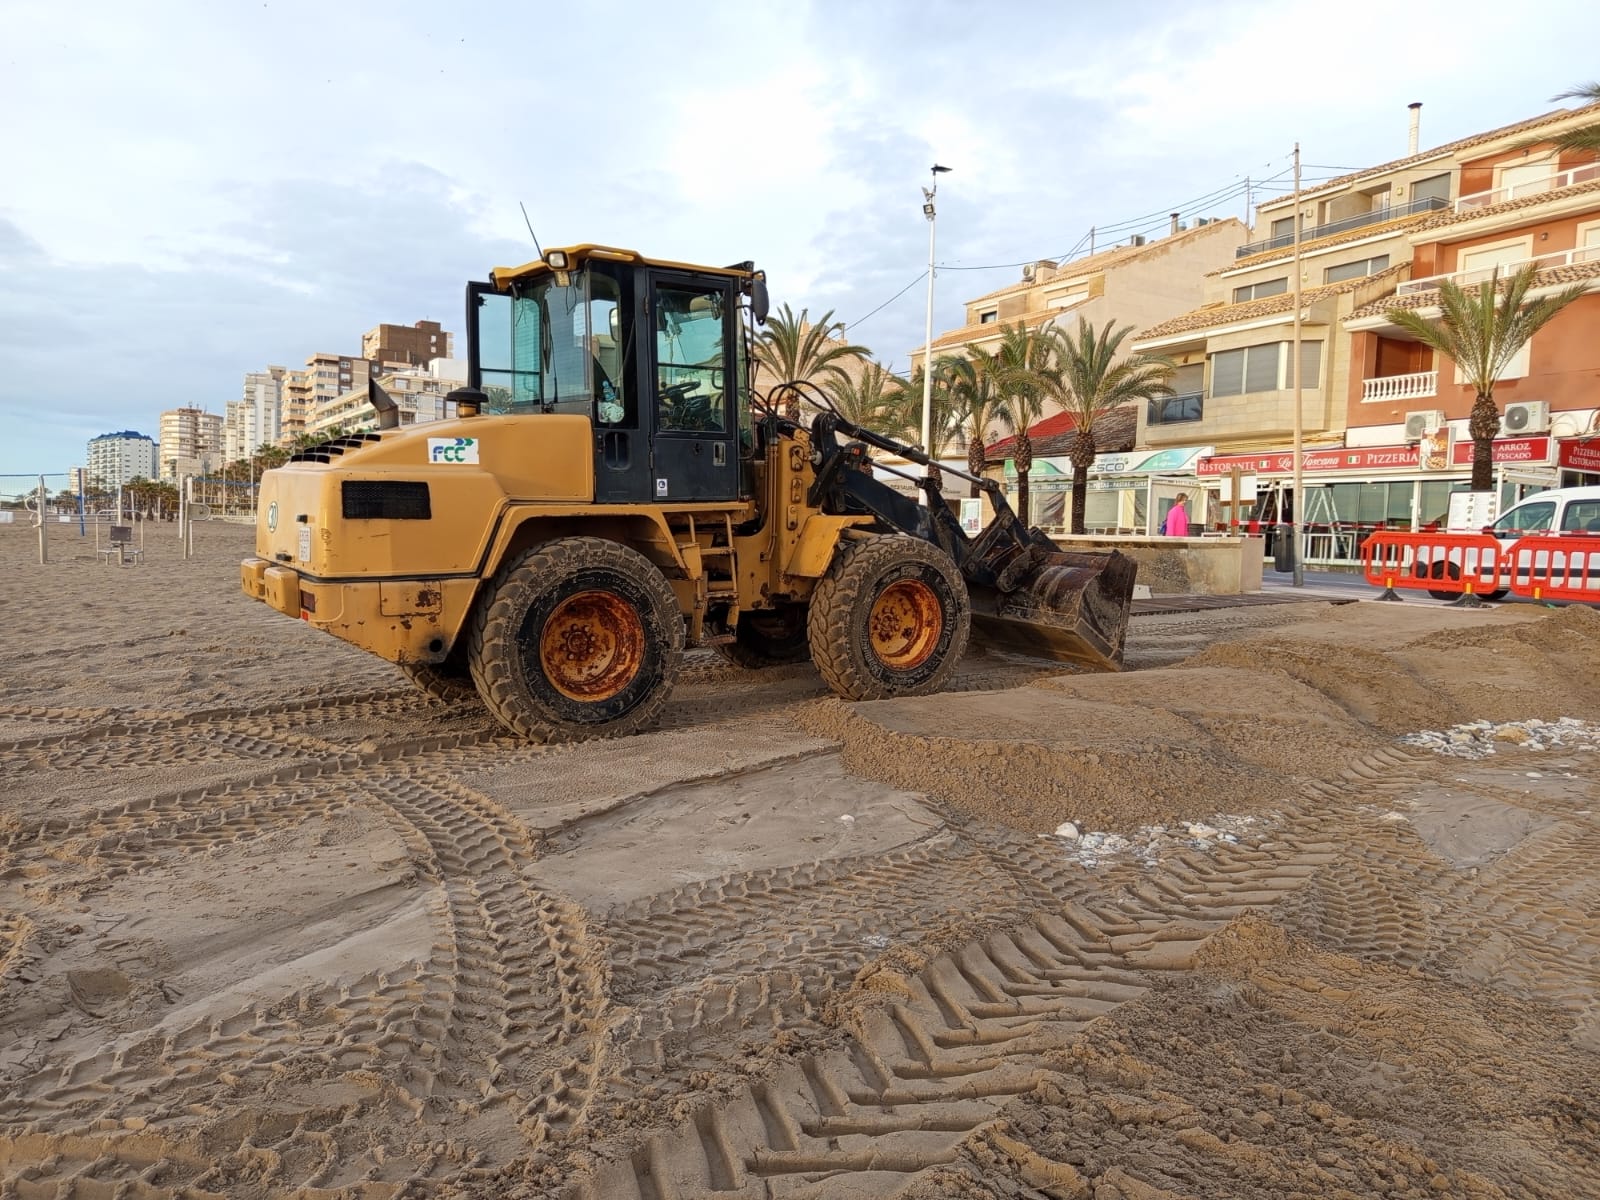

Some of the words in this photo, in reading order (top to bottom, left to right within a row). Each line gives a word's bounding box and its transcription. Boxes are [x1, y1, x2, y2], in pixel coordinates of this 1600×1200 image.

[433, 446, 466, 462] FCC
[1301, 453, 1340, 466] Toscana
[1366, 453, 1418, 464] PIZZERIA
[1496, 452, 1532, 460] PESCADO
